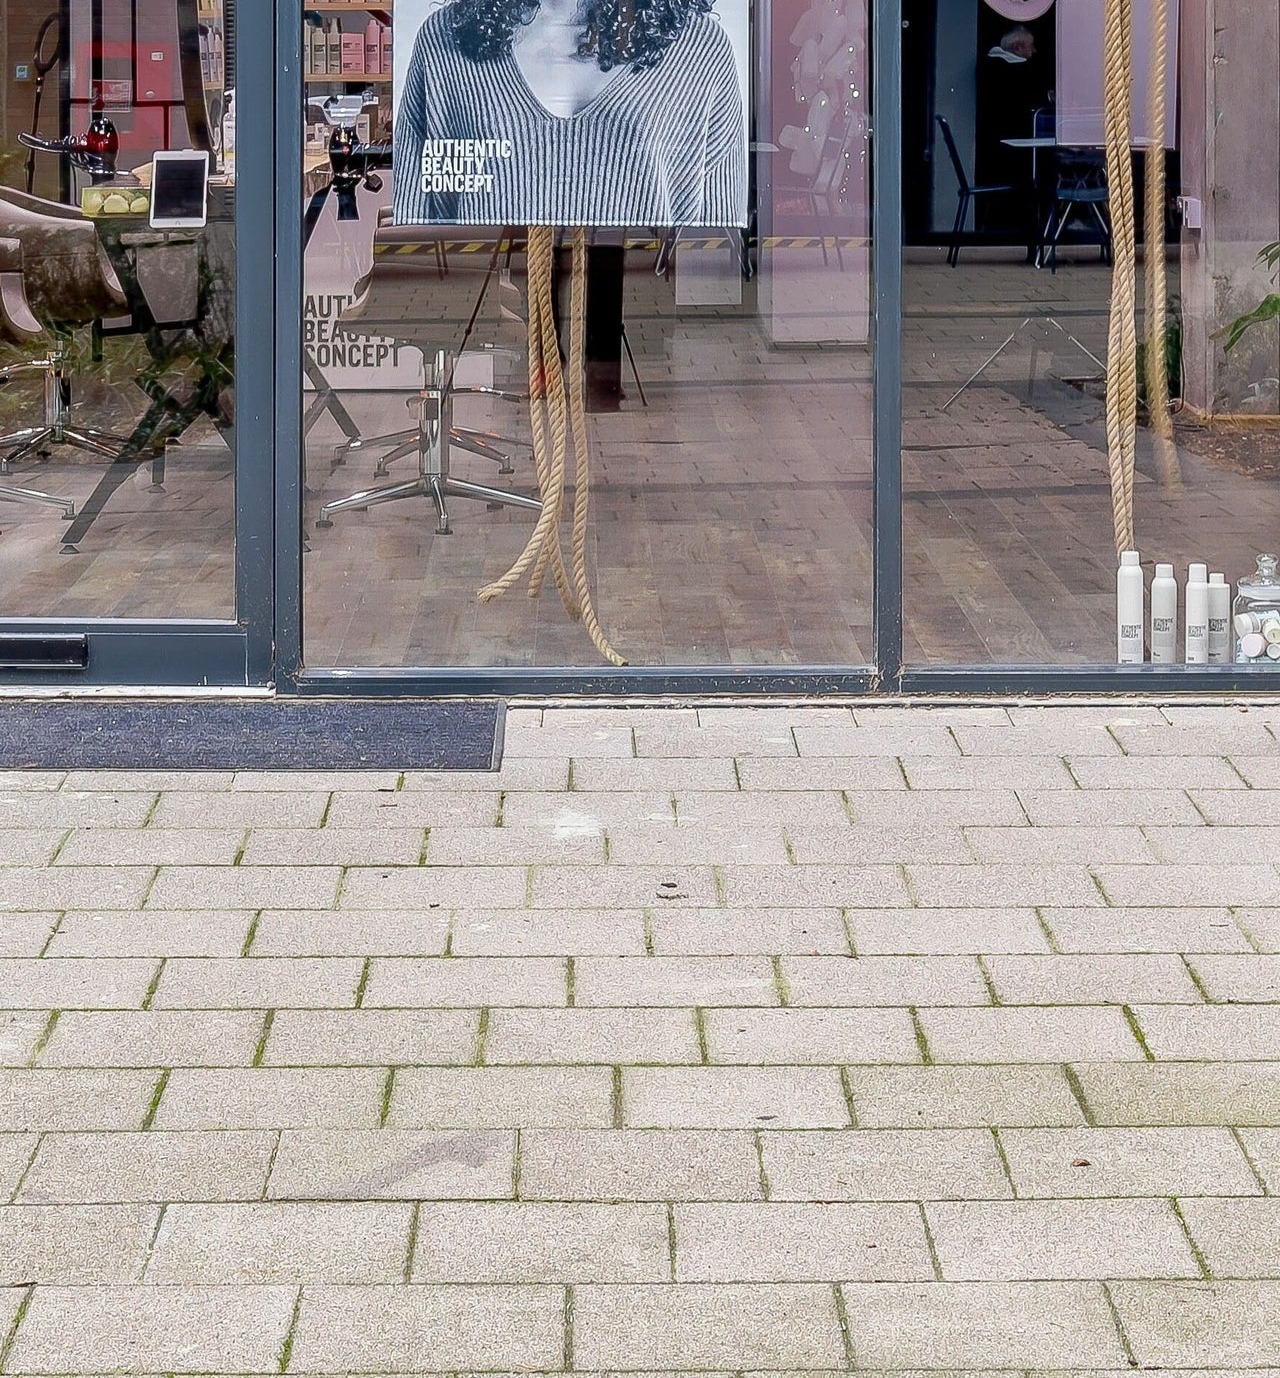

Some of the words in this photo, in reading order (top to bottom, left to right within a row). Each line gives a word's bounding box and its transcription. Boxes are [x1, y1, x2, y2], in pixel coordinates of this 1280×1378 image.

[422, 139, 512, 158] AUTHENTIC
[422, 157, 486, 174] BEAUTY
[422, 174, 494, 192] CONCEPT
[304, 320, 387, 343] BEA
